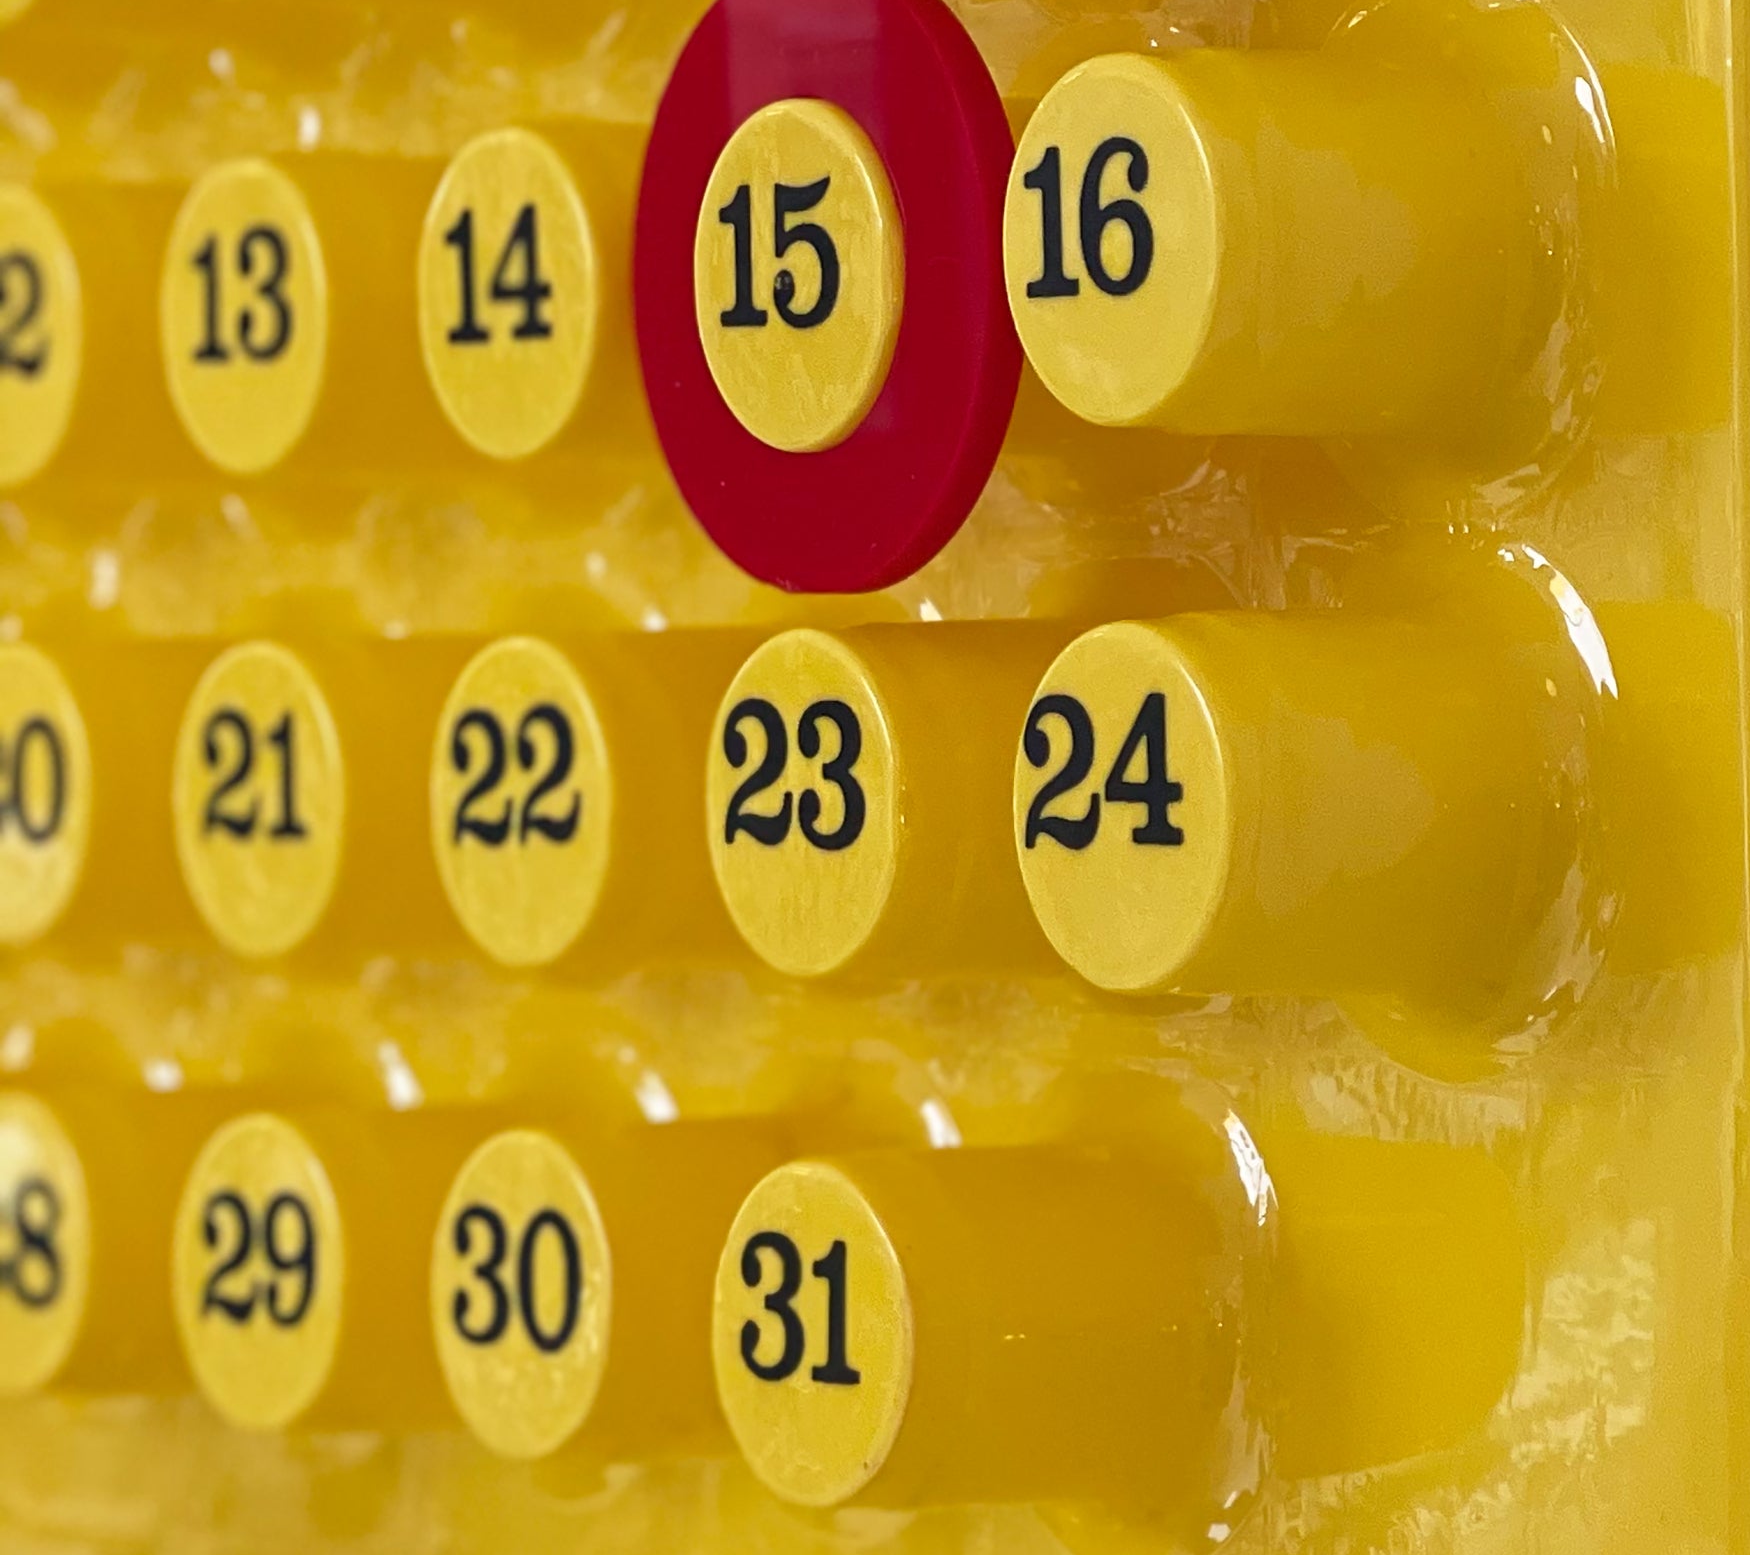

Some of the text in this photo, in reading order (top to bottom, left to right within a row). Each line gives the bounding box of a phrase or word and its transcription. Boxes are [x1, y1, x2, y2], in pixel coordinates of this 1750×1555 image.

[445, 204, 552, 345] 14
[719, 176, 839, 329] 15
[1021, 137, 1153, 298] 16
[0, 251, 47, 379] 2
[192, 225, 293, 364] 13
[0, 715, 68, 845] 0
[203, 708, 307, 841] 21
[451, 703, 580, 847] 22
[723, 698, 865, 851] 23
[1023, 693, 1184, 850] 24
[0, 1178, 63, 1310] 8
[202, 1190, 316, 1328] 29
[453, 1204, 582, 1353] 30
[741, 1231, 860, 1385] 31
